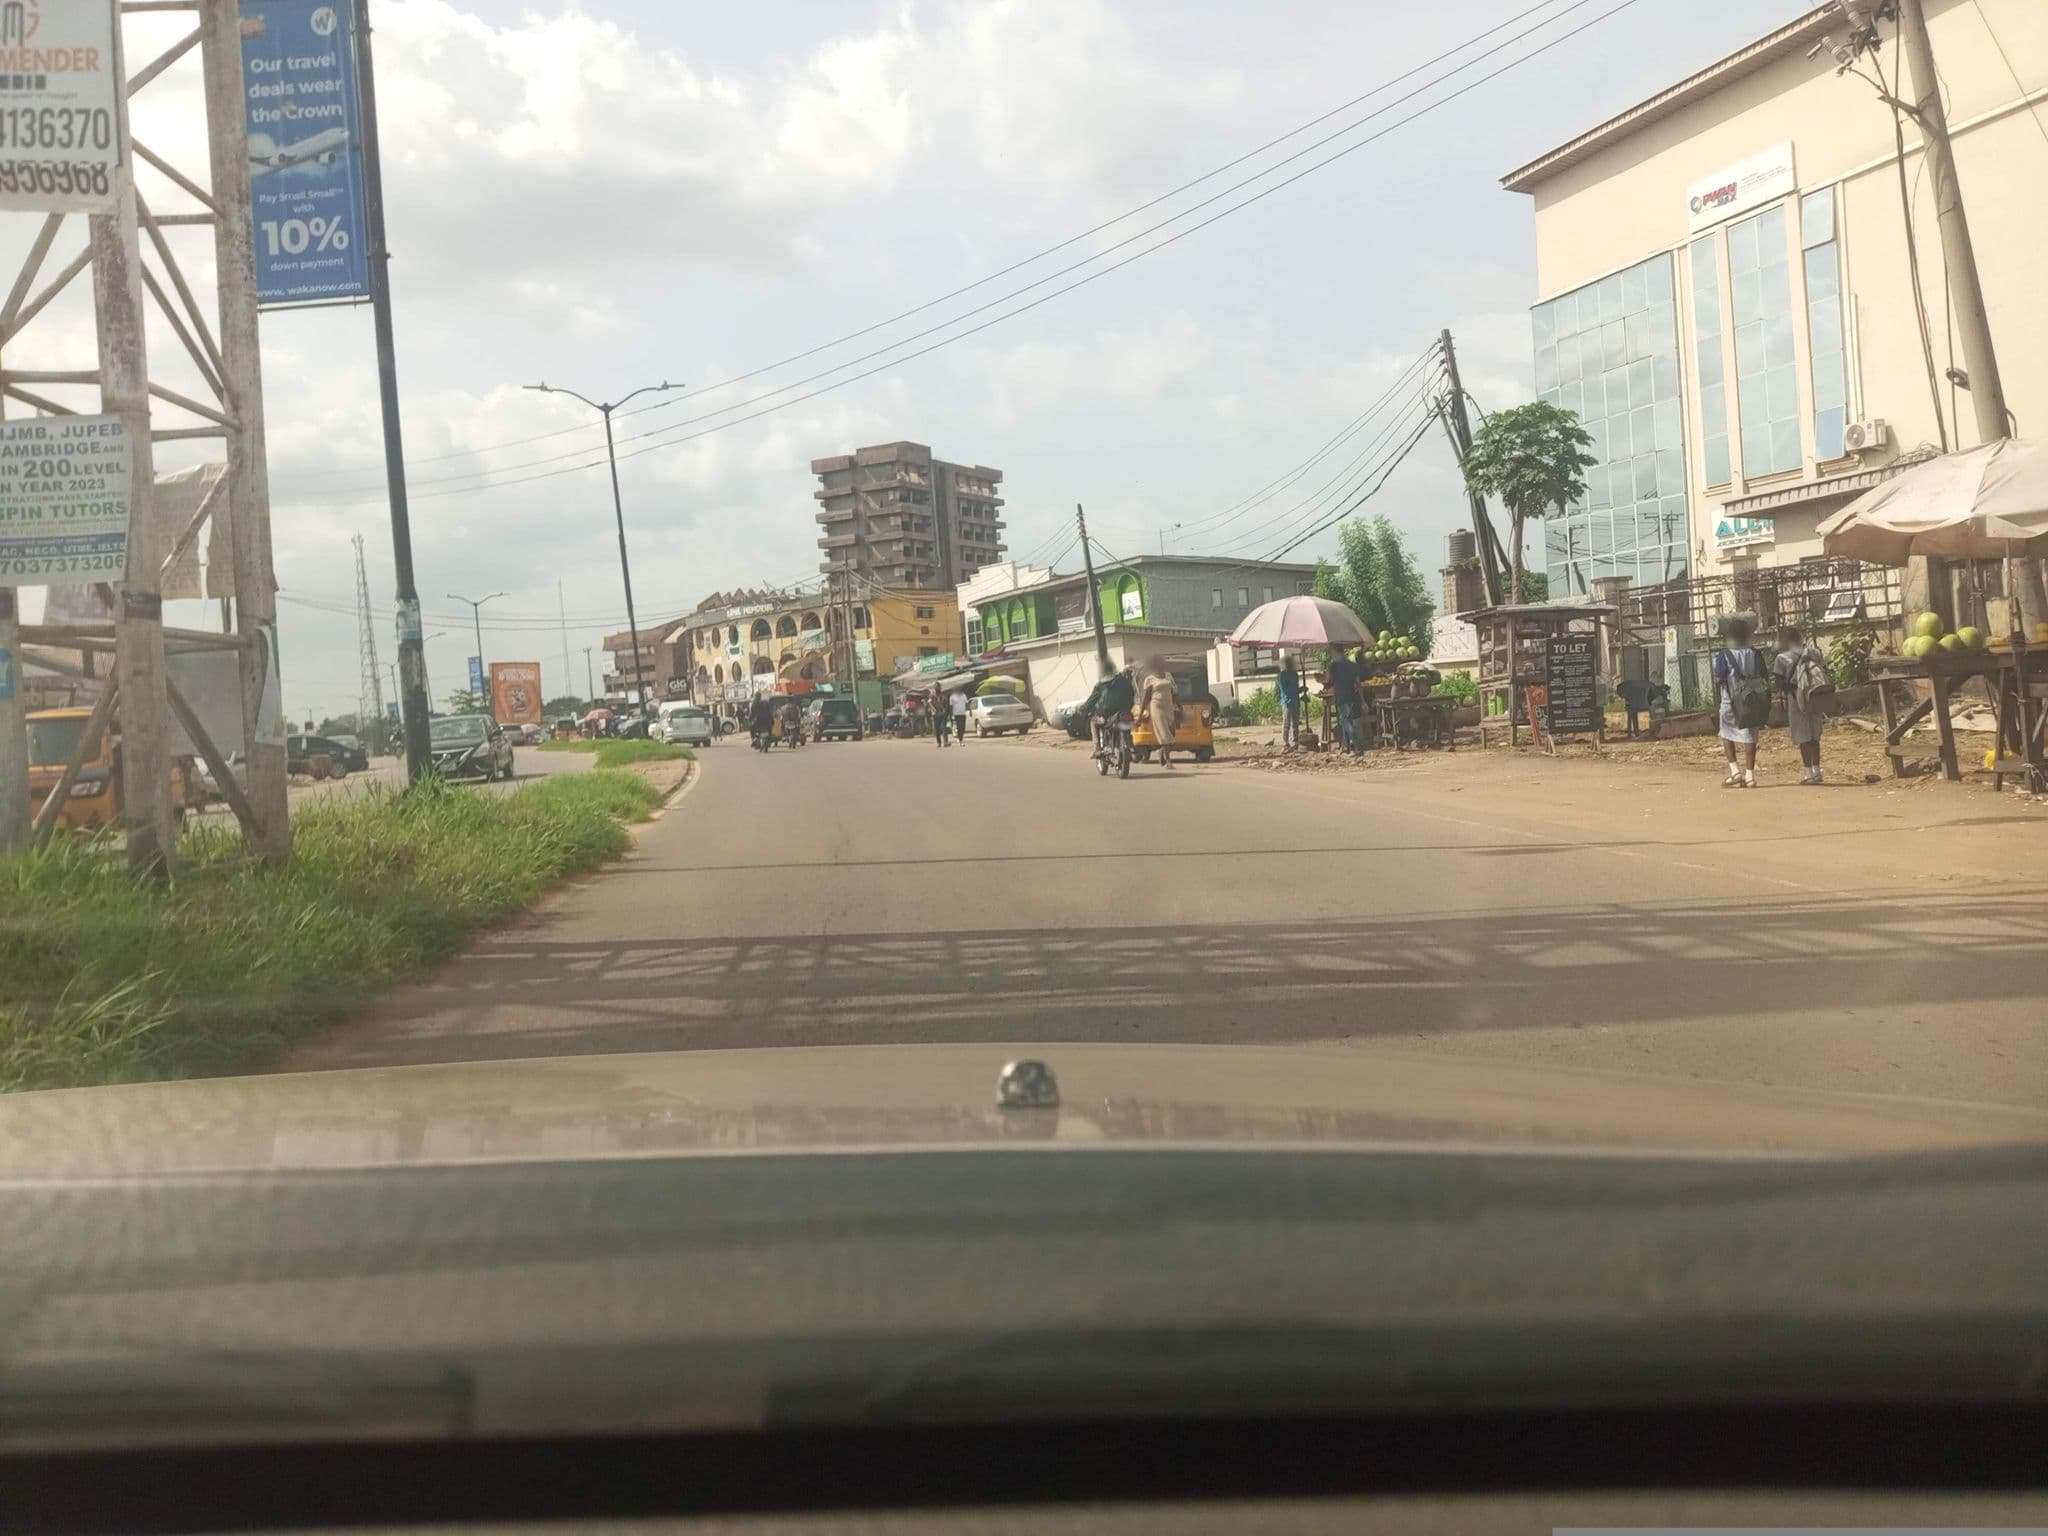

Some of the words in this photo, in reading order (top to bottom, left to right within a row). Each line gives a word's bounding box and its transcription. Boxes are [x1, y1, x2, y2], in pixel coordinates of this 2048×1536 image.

[250, 58, 281, 73] Our
[287, 51, 336, 70] travel
[249, 80, 295, 98] deals
[299, 79, 342, 94] wear
[252, 107, 281, 123] the
[285, 104, 342, 120] Crown
[259, 193, 278, 204] Pay
[293, 203, 316, 213] with
[261, 215, 349, 256] 10%
[270, 262, 299, 272] down
[300, 257, 344, 271] payment
[61, 423, 122, 438] JUPEB
[1, 442, 100, 457] AMBRIDGE
[23, 459, 72, 478] 200
[74, 462, 126, 475] LEVEL
[18, 481, 63, 493] YEAR
[69, 479, 105, 491] 2023
[49, 501, 126, 518] TUTORS
[1553, 644, 1567, 654] TO
[1569, 643, 1587, 653] LET
